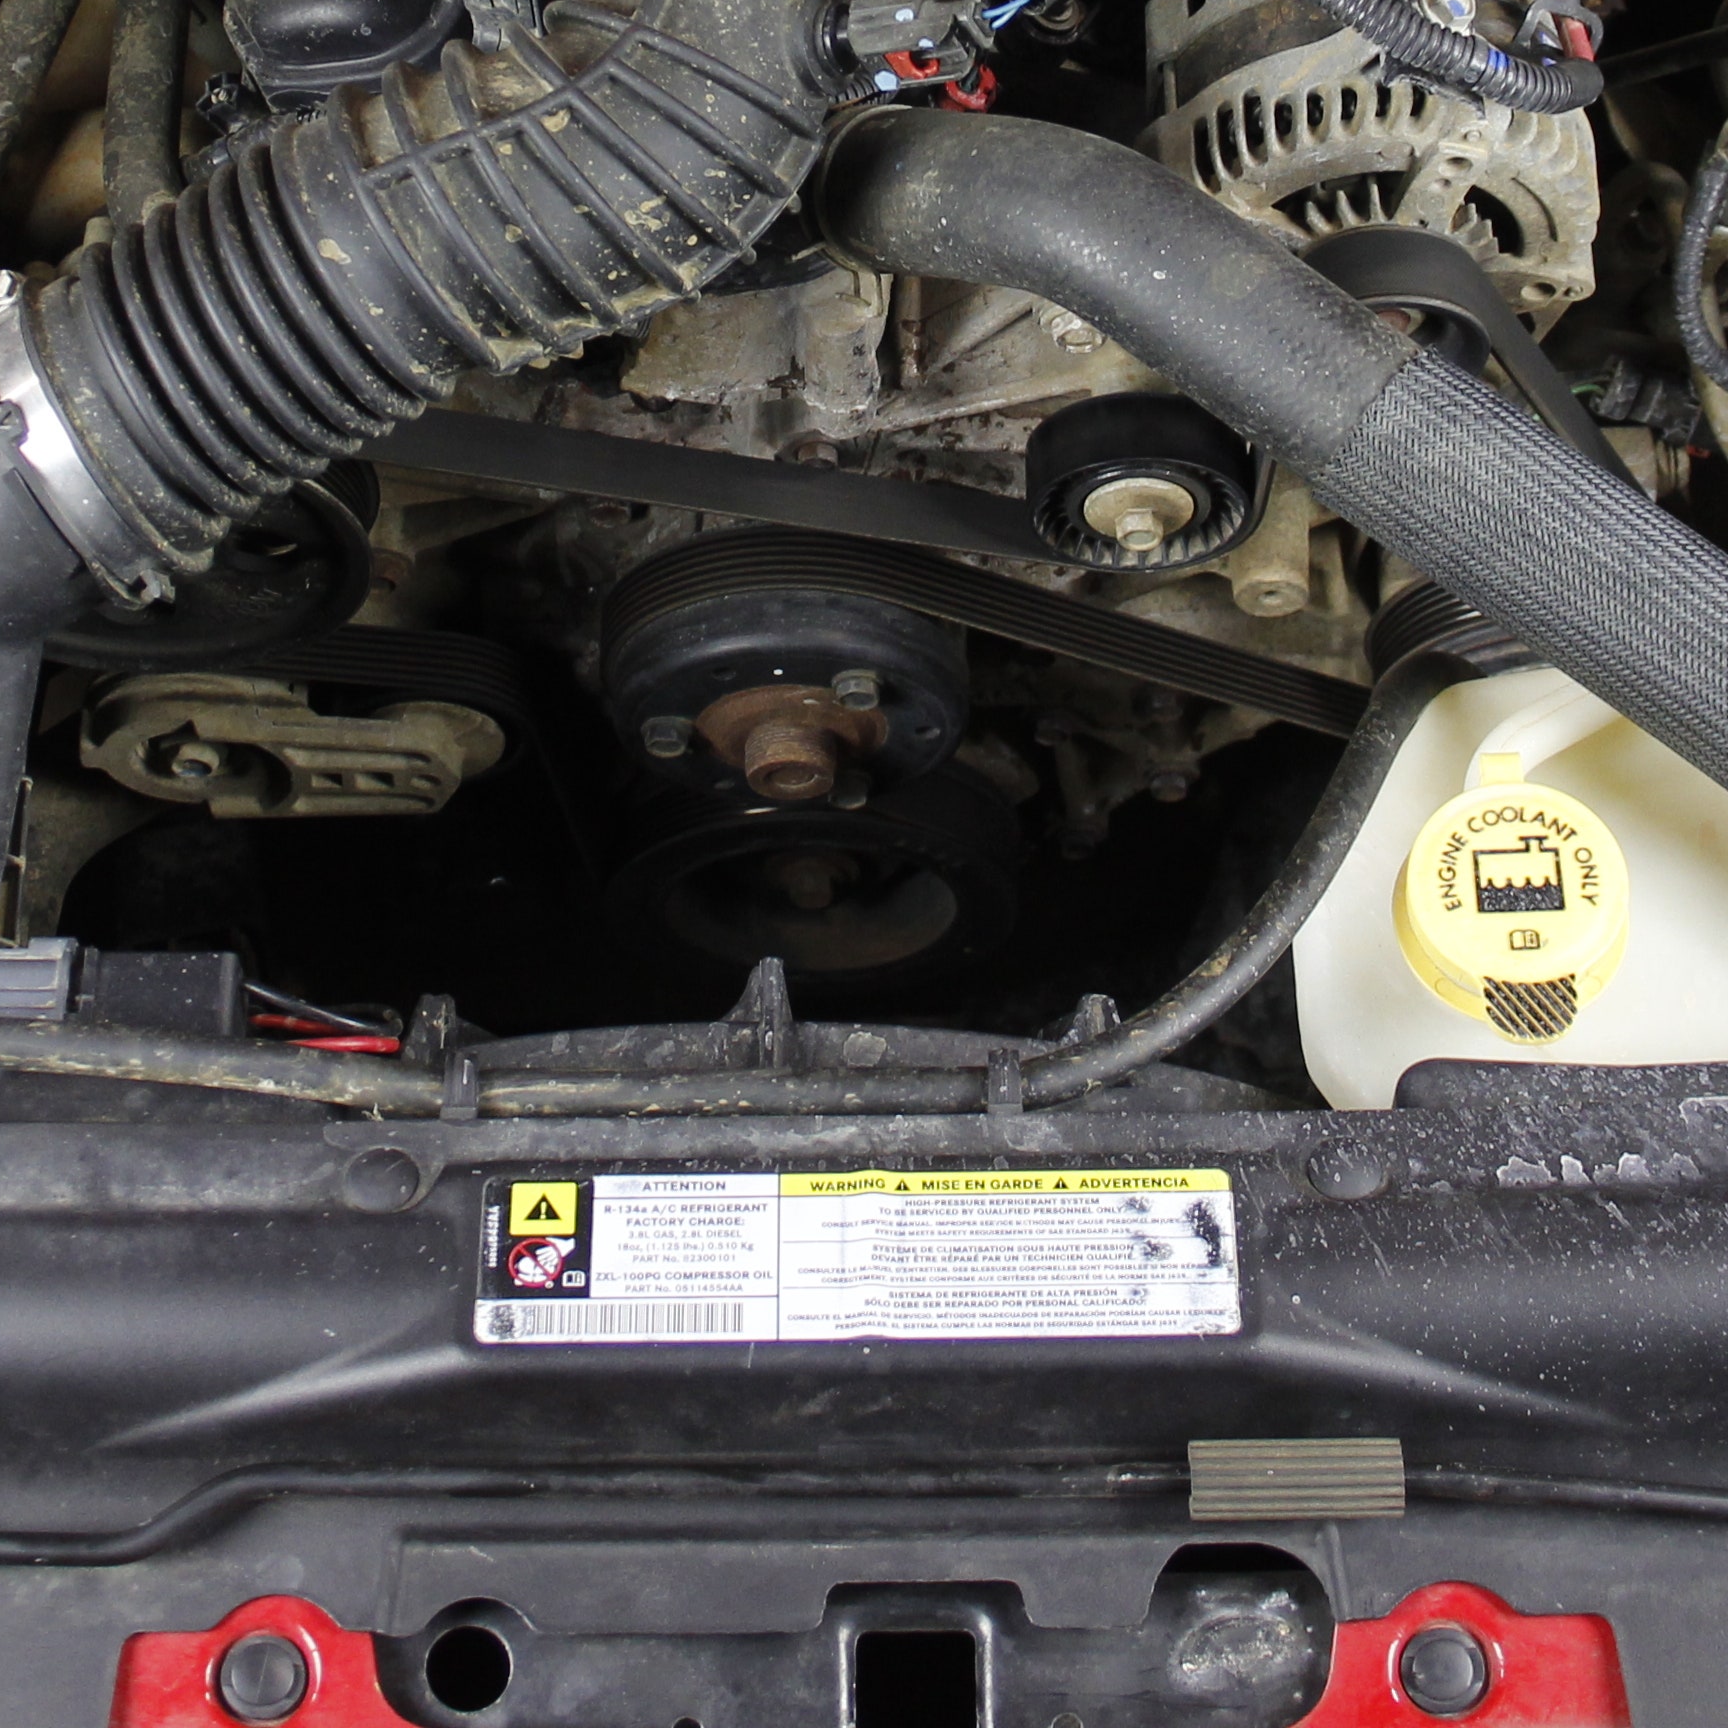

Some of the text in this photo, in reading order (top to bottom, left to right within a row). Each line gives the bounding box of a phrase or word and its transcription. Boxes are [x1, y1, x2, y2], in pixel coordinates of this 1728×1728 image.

[1438, 806, 1599, 912] ENGINE COOLANT ONLY
[642, 1181, 726, 1192] ATTENTION
[810, 1178, 886, 1191] WARNING
[922, 1178, 1043, 1191] MISE EN GARDE
[1079, 1177, 1189, 1189] ADVERTENCIA
[905, 1197, 1100, 1207] HIGH-PRESSURE REFRIGERANT SYSTEM
[604, 1203, 768, 1215] R-134a A/C REFRIGERANT
[879, 1207, 891, 1216] TO
[909, 1208, 958, 1216] SERVICED
[961, 1208, 973, 1216] BY
[976, 1207, 1030, 1216] QUALIFIED
[1033, 1207, 1092, 1215] PERSONNEL
[626, 1216, 745, 1227] FACTORY CHARGE:
[705, 1229, 742, 1238] DIESEL
[920, 1246, 933, 1254] DE
[936, 1245, 1014, 1254] CLIMATISATION
[1016, 1245, 1044, 1253] SOUS
[1047, 1244, 1080, 1252] HAUTE
[1083, 1244, 1134, 1252] PRESSION
[632, 1254, 658, 1263] PART
[871, 1253, 909, 1263] DEVANT
[981, 1254, 1001, 1263] PAR
[1003, 1254, 1019, 1262] UN
[664, 1270, 749, 1281] COMPRESSOR
[753, 1270, 773, 1280] OIL
[625, 1284, 650, 1294] PART
[889, 1288, 1118, 1299] SISTEMA DE REFRIGERANTE DE ALTA PRESIÓN
[893, 1300, 919, 1309] DEBE
[922, 1300, 941, 1309] SER
[944, 1300, 998, 1309] REPARADO
[1001, 1299, 1022, 1308] POR
[1025, 1299, 1078, 1307] PERSONAL
